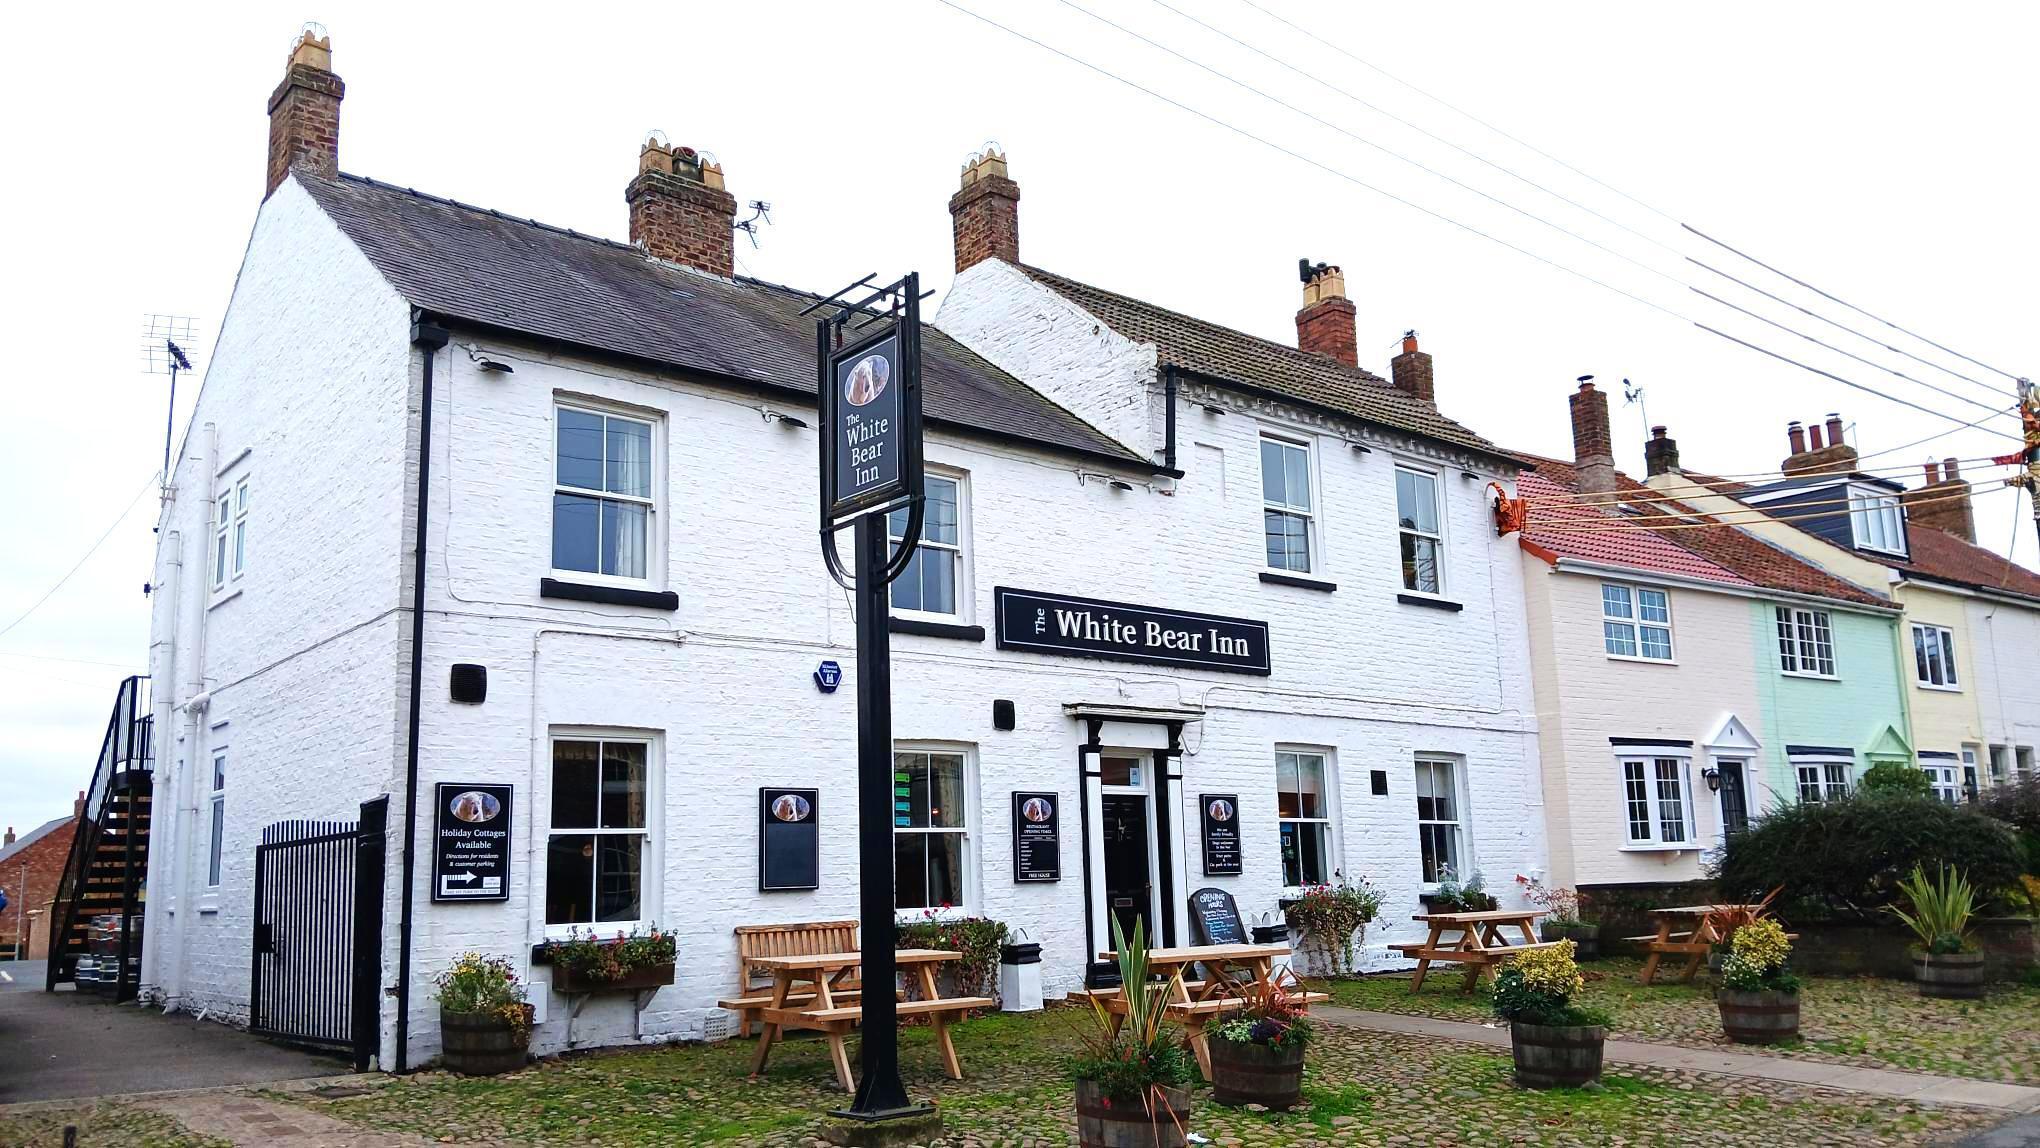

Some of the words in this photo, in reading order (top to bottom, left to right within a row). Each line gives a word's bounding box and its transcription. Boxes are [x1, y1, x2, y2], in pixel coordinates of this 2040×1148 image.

[846, 413, 860, 427] The
[846, 418, 888, 447] White
[851, 441, 884, 467] Bear
[855, 464, 880, 487] Inn
[1035, 607, 1046, 635] The
[1054, 608, 1138, 645] White
[1144, 621, 1203, 651] Bear
[1208, 628, 1250, 657] Inn
[441, 829, 472, 838] Holiday
[473, 829, 506, 838] Cottages
[455, 841, 492, 849] Available
[469, 852, 478, 860] for
[476, 860, 495, 868] parking
[1199, 892, 1225, 903] OPENING
[1208, 900, 1224, 909] HOURS
